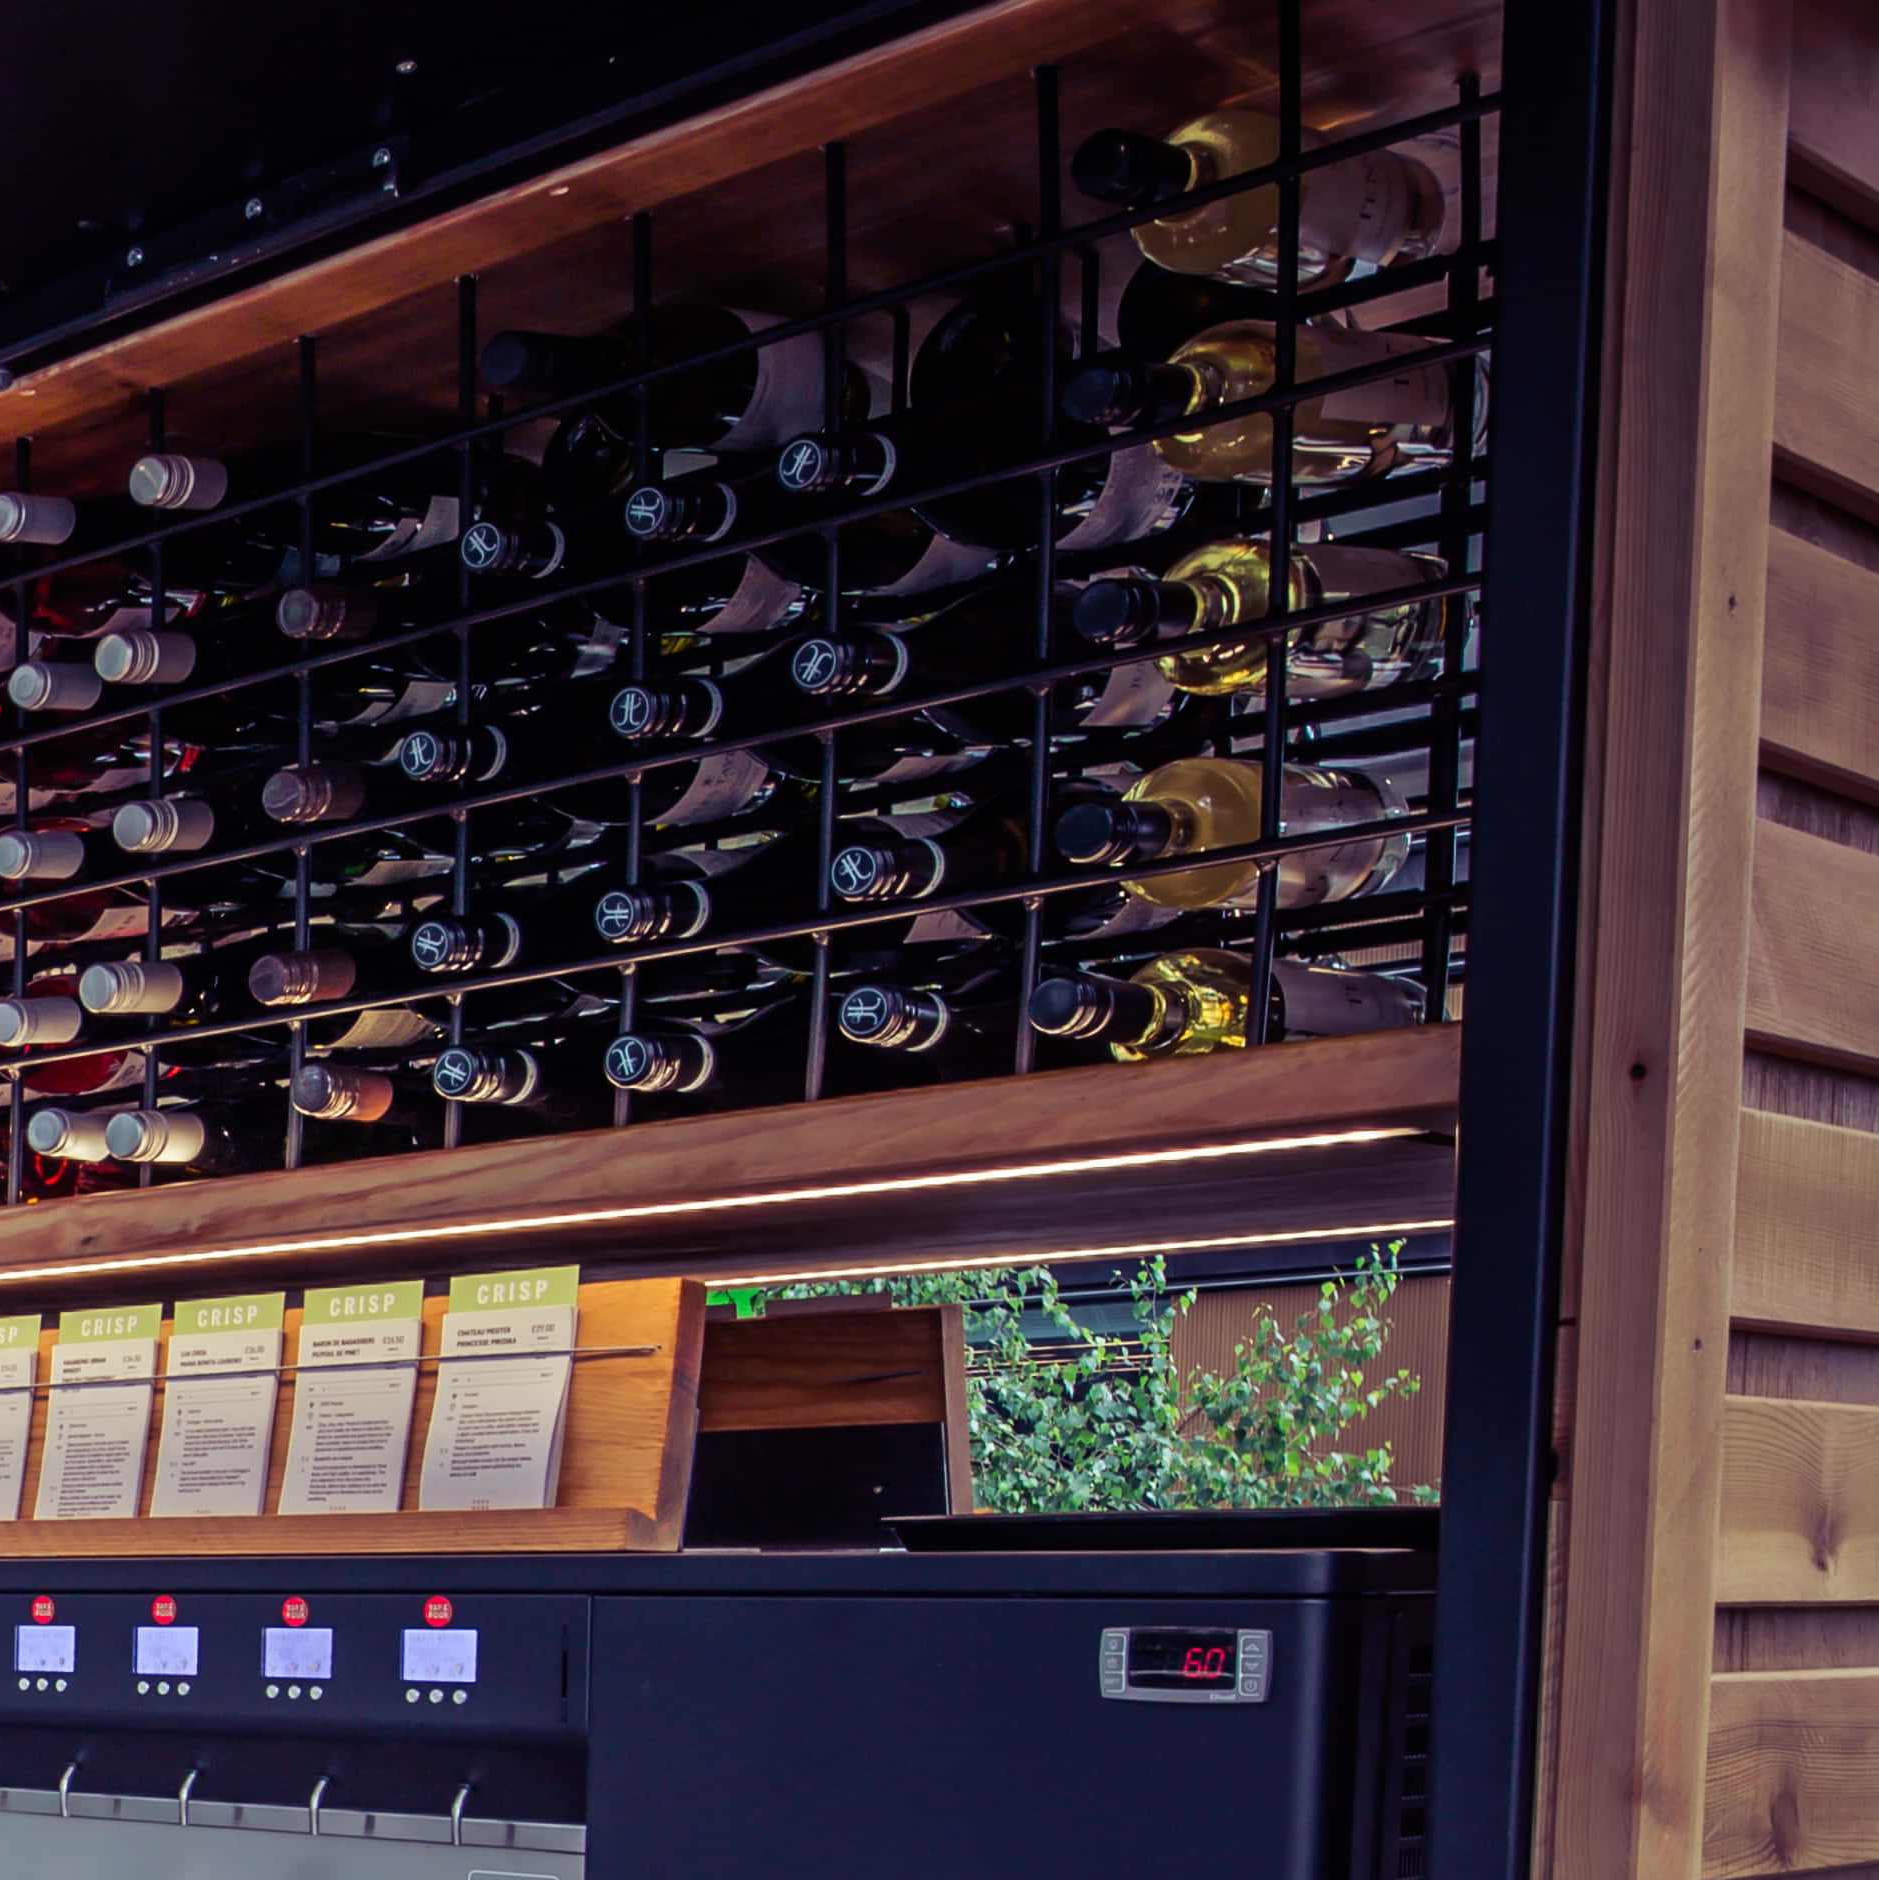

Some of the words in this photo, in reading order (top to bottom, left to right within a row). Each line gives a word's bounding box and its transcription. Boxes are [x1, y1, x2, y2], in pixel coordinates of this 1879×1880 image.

[477, 1280, 550, 1305] CRISP
[197, 1305, 259, 1328] CRISP
[330, 1293, 397, 1317] CRISP
[81, 1315, 139, 1337] CRISP
